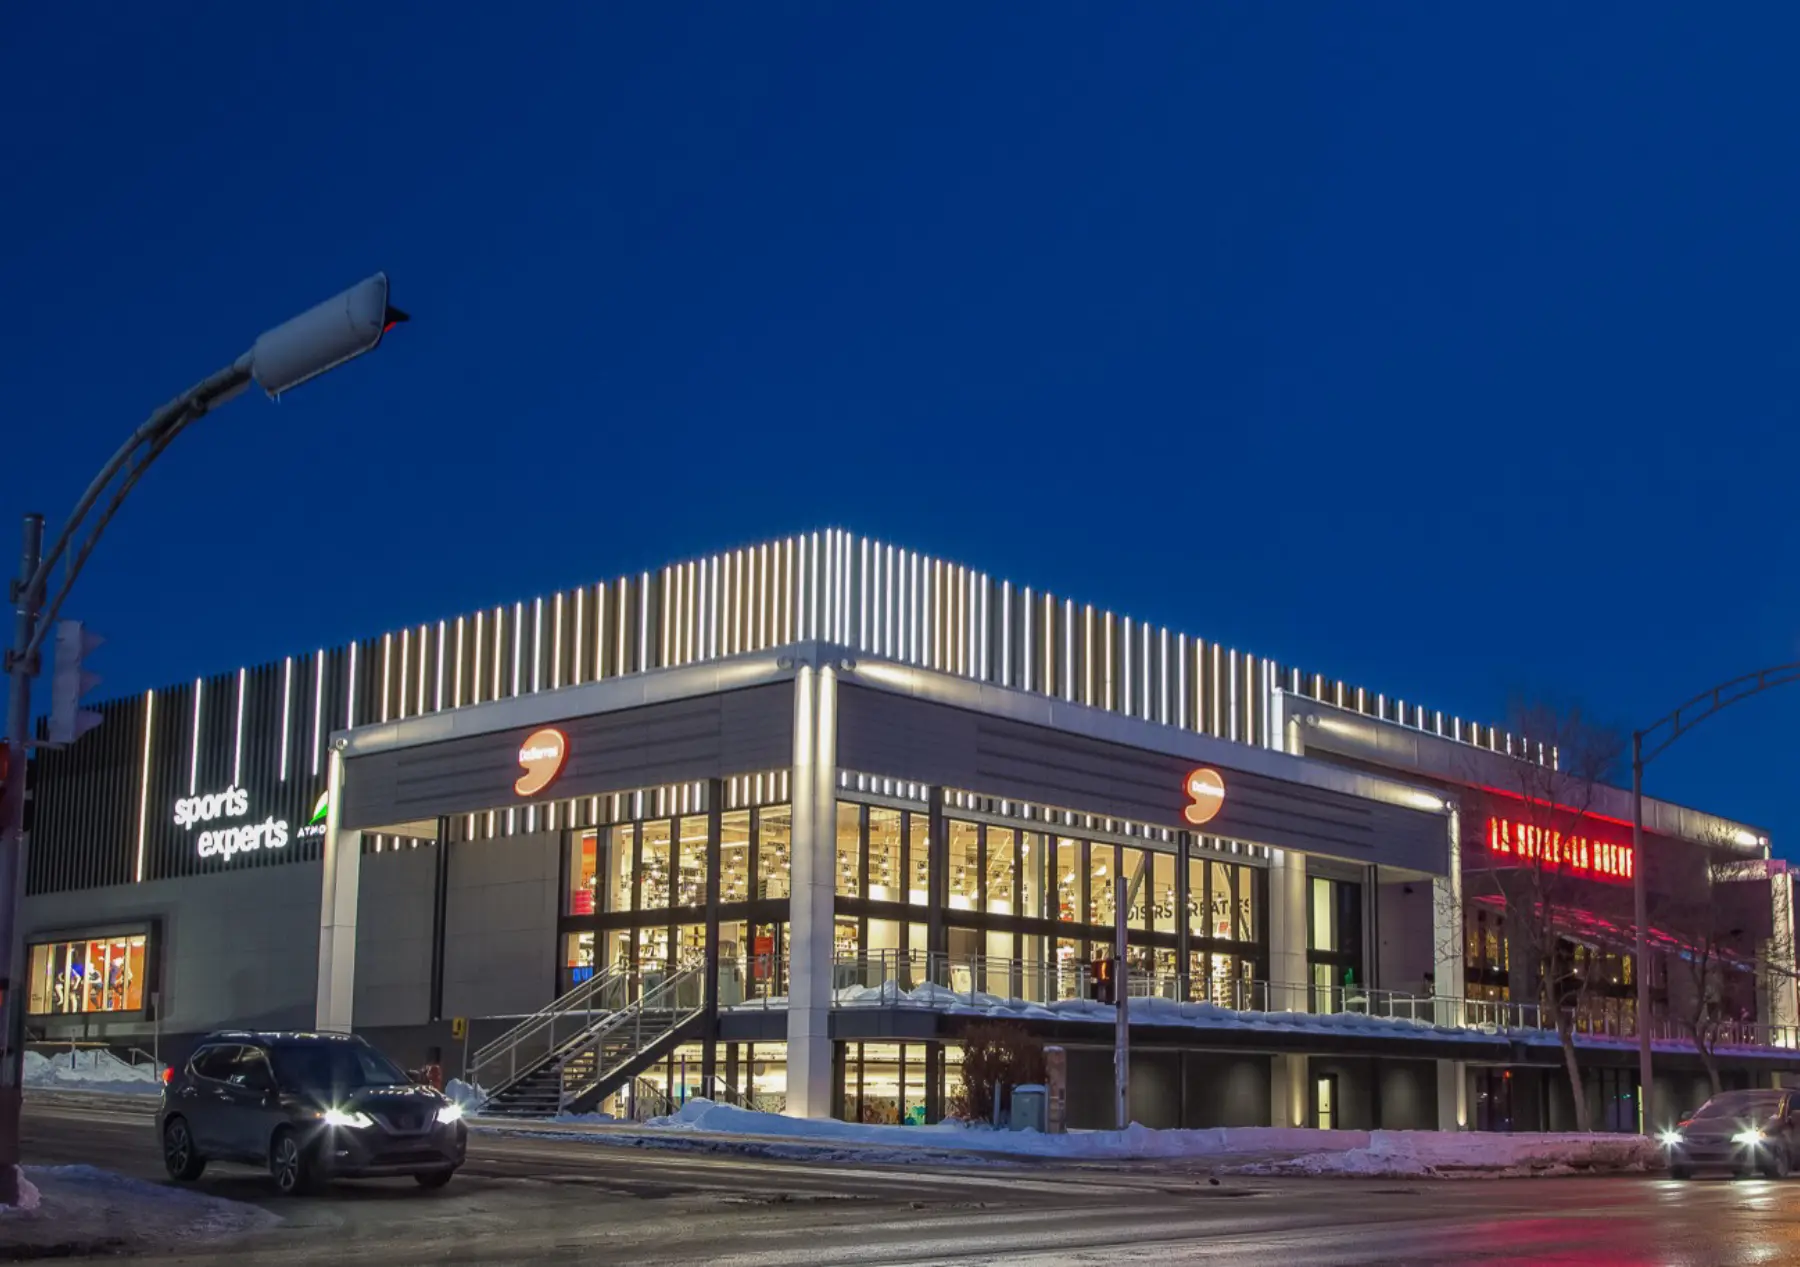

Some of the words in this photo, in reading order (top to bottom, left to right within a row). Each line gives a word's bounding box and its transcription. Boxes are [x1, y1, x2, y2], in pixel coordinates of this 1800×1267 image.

[174, 784, 248, 829] sports
[198, 815, 288, 861] experts
[1572, 836, 1588, 868] LA
